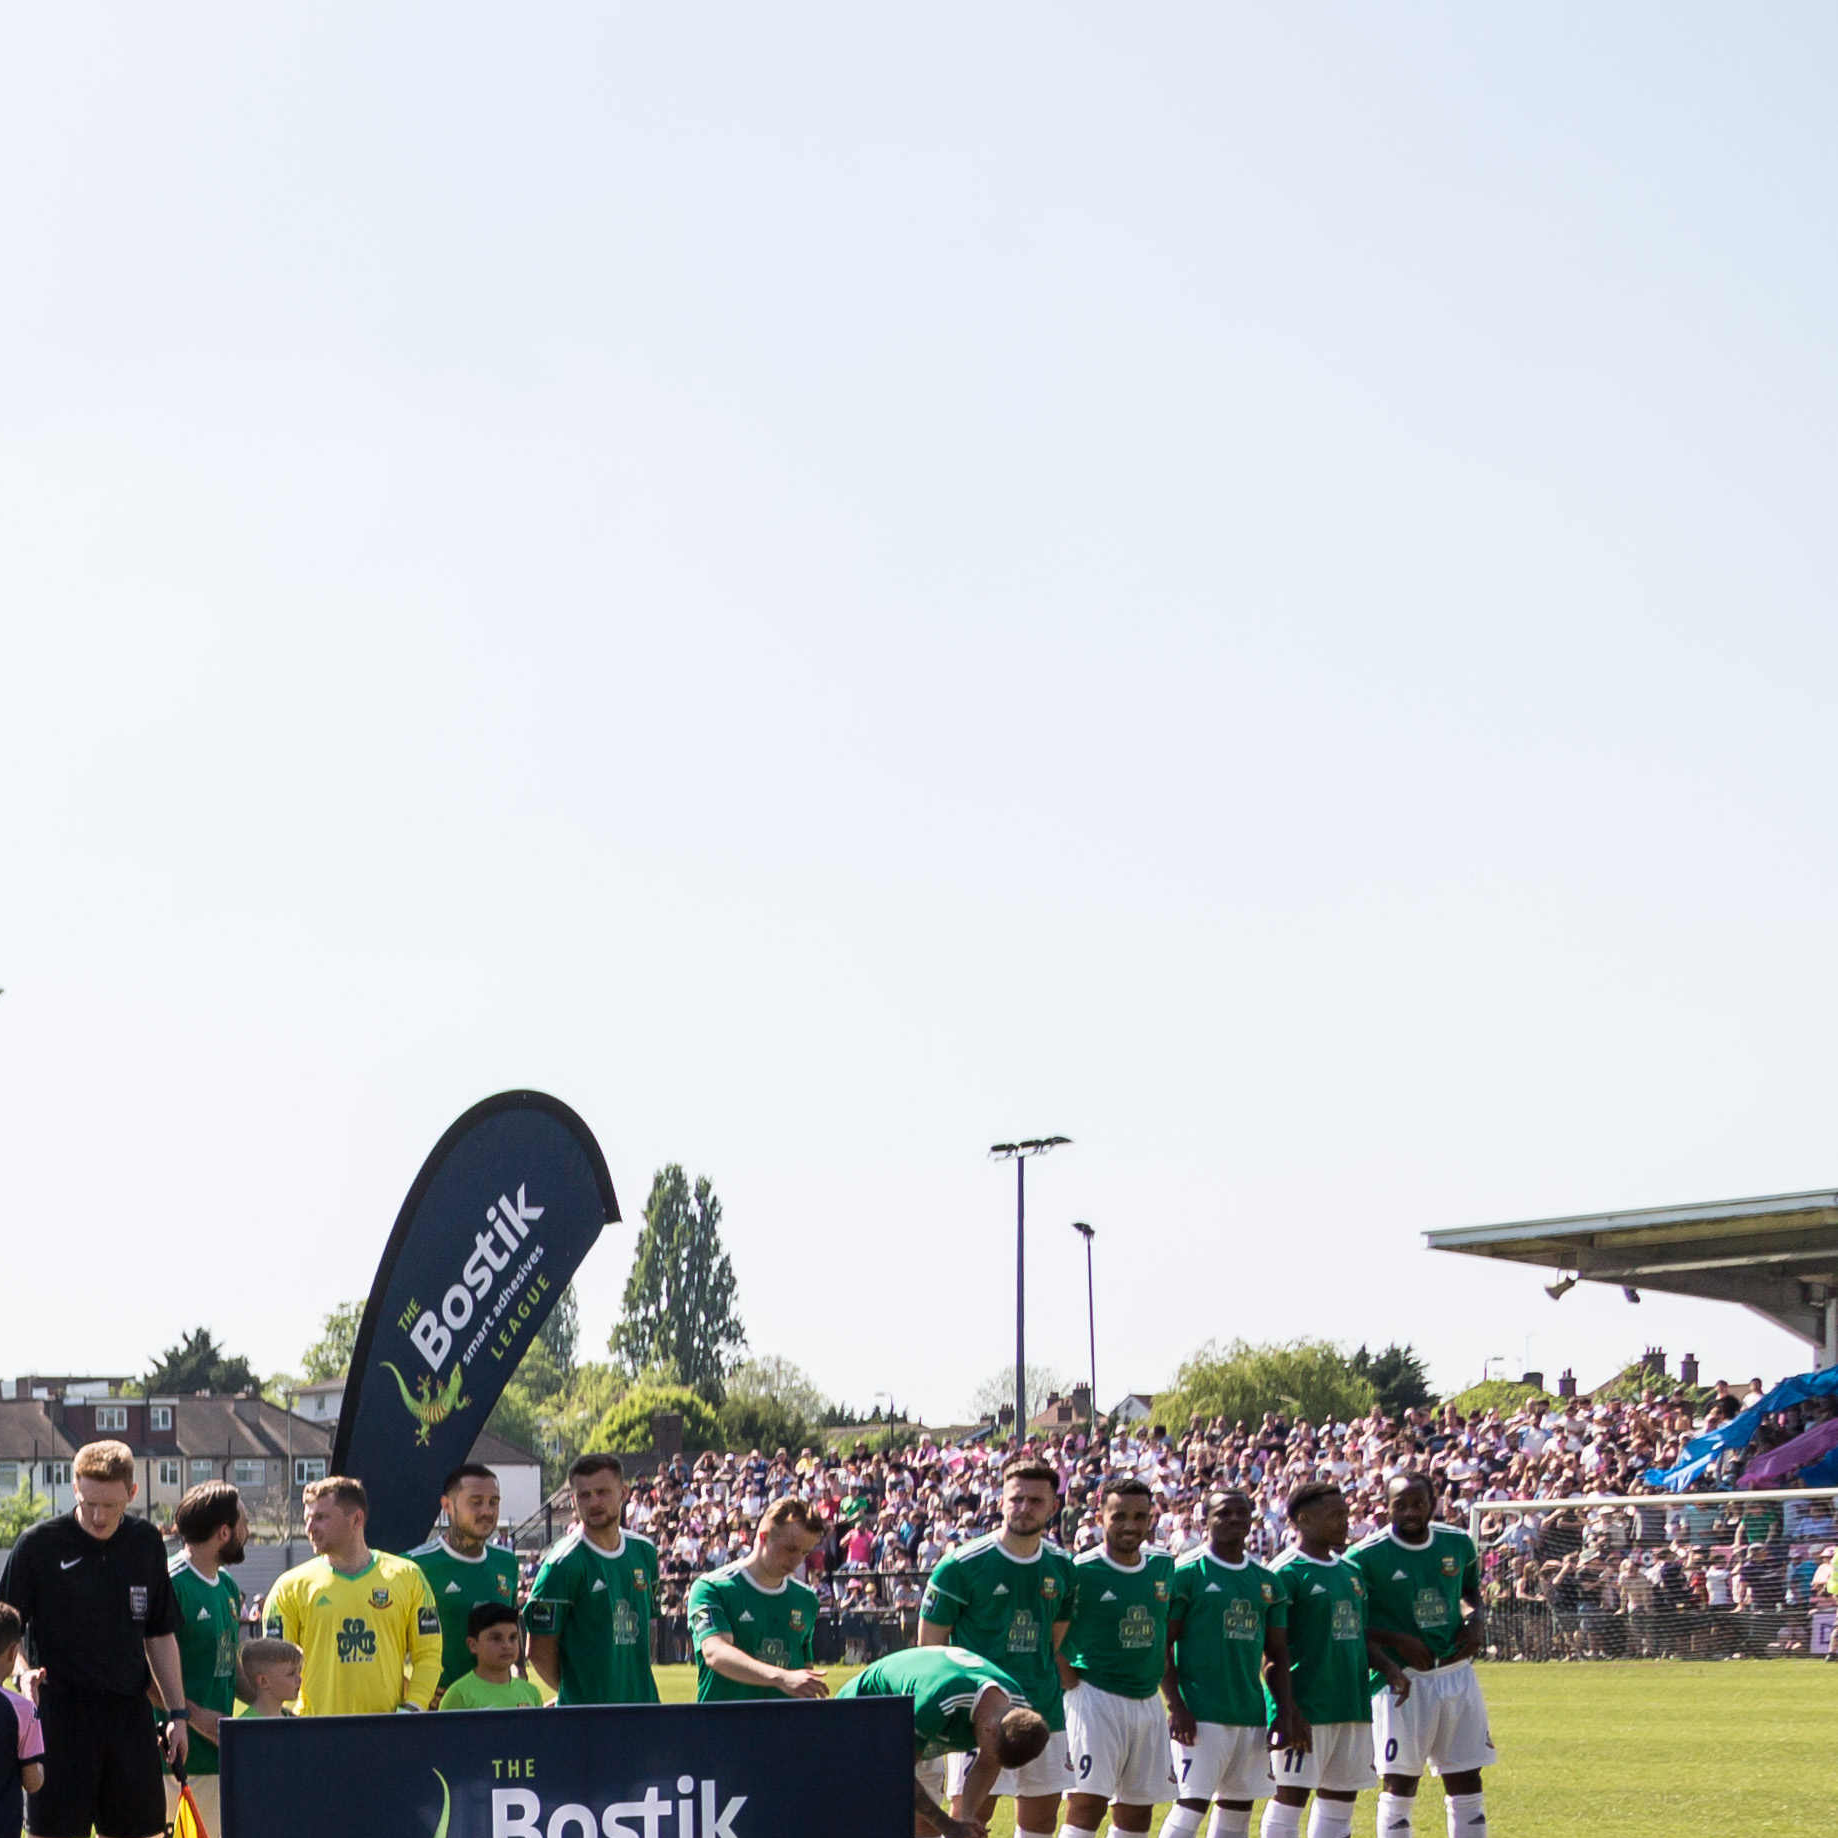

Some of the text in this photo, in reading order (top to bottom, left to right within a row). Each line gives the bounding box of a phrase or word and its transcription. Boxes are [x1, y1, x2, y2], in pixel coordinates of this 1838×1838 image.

[410, 1181, 545, 1373] Bostik
[398, 1296, 421, 1332] THE
[463, 1244, 544, 1366] smart adhesives
[491, 1273, 550, 1361] LEAGUE
[492, 1759, 535, 1779] THE
[1079, 1754, 1093, 1779] 9
[1181, 1759, 1192, 1783] 7
[1283, 1749, 1304, 1773] 11
